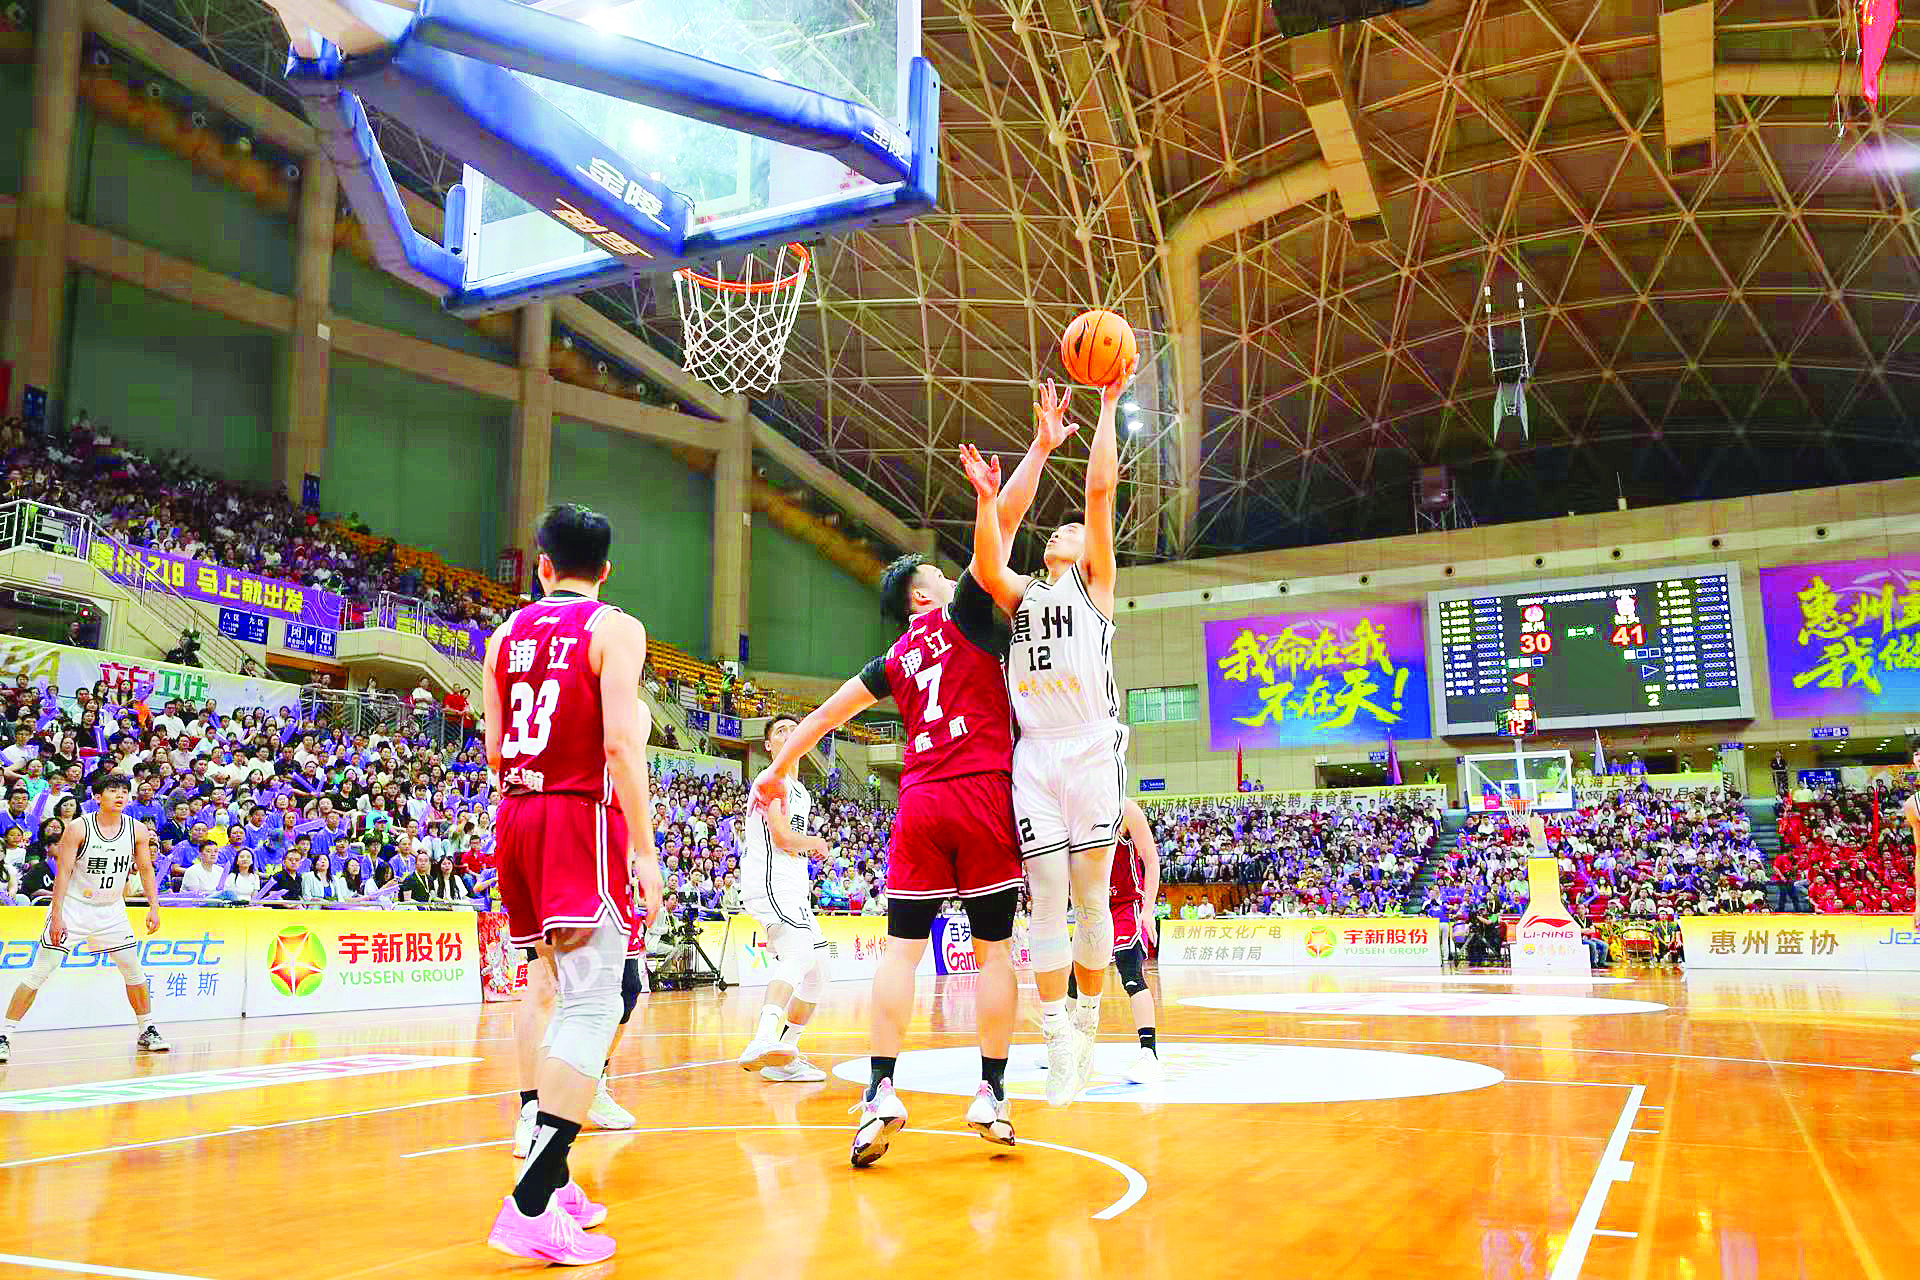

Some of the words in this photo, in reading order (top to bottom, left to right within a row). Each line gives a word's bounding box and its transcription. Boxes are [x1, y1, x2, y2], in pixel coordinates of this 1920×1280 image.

[584, 156, 666, 222] 金陵
[196, 567, 304, 614] 马上就出发
[1519, 633, 1552, 654] 30
[1612, 624, 1645, 646] 41
[507, 635, 578, 674] 浦江
[898, 627, 953, 679] 浦江
[1027, 645, 1052, 672] 12
[914, 661, 944, 723] 7
[1647, 693, 1660, 706] 2
[501, 679, 561, 760] 33
[99, 876, 114, 890] 10
[1171, 925, 1282, 940] 惠州市文化广电
[1343, 928, 1428, 945] 宇新股份
[1523, 931, 1574, 939] LI-NING
[1708, 928, 1840, 956] 惠州篮协
[338, 932, 464, 966] 宇新股份
[1182, 945, 1262, 961] 旅游体育局
[1343, 946, 1385, 955] YUSSEN
[1389, 946, 1429, 955] GROUP
[339, 969, 405, 986] YUSSEN
[410, 967, 464, 984] GROUP
